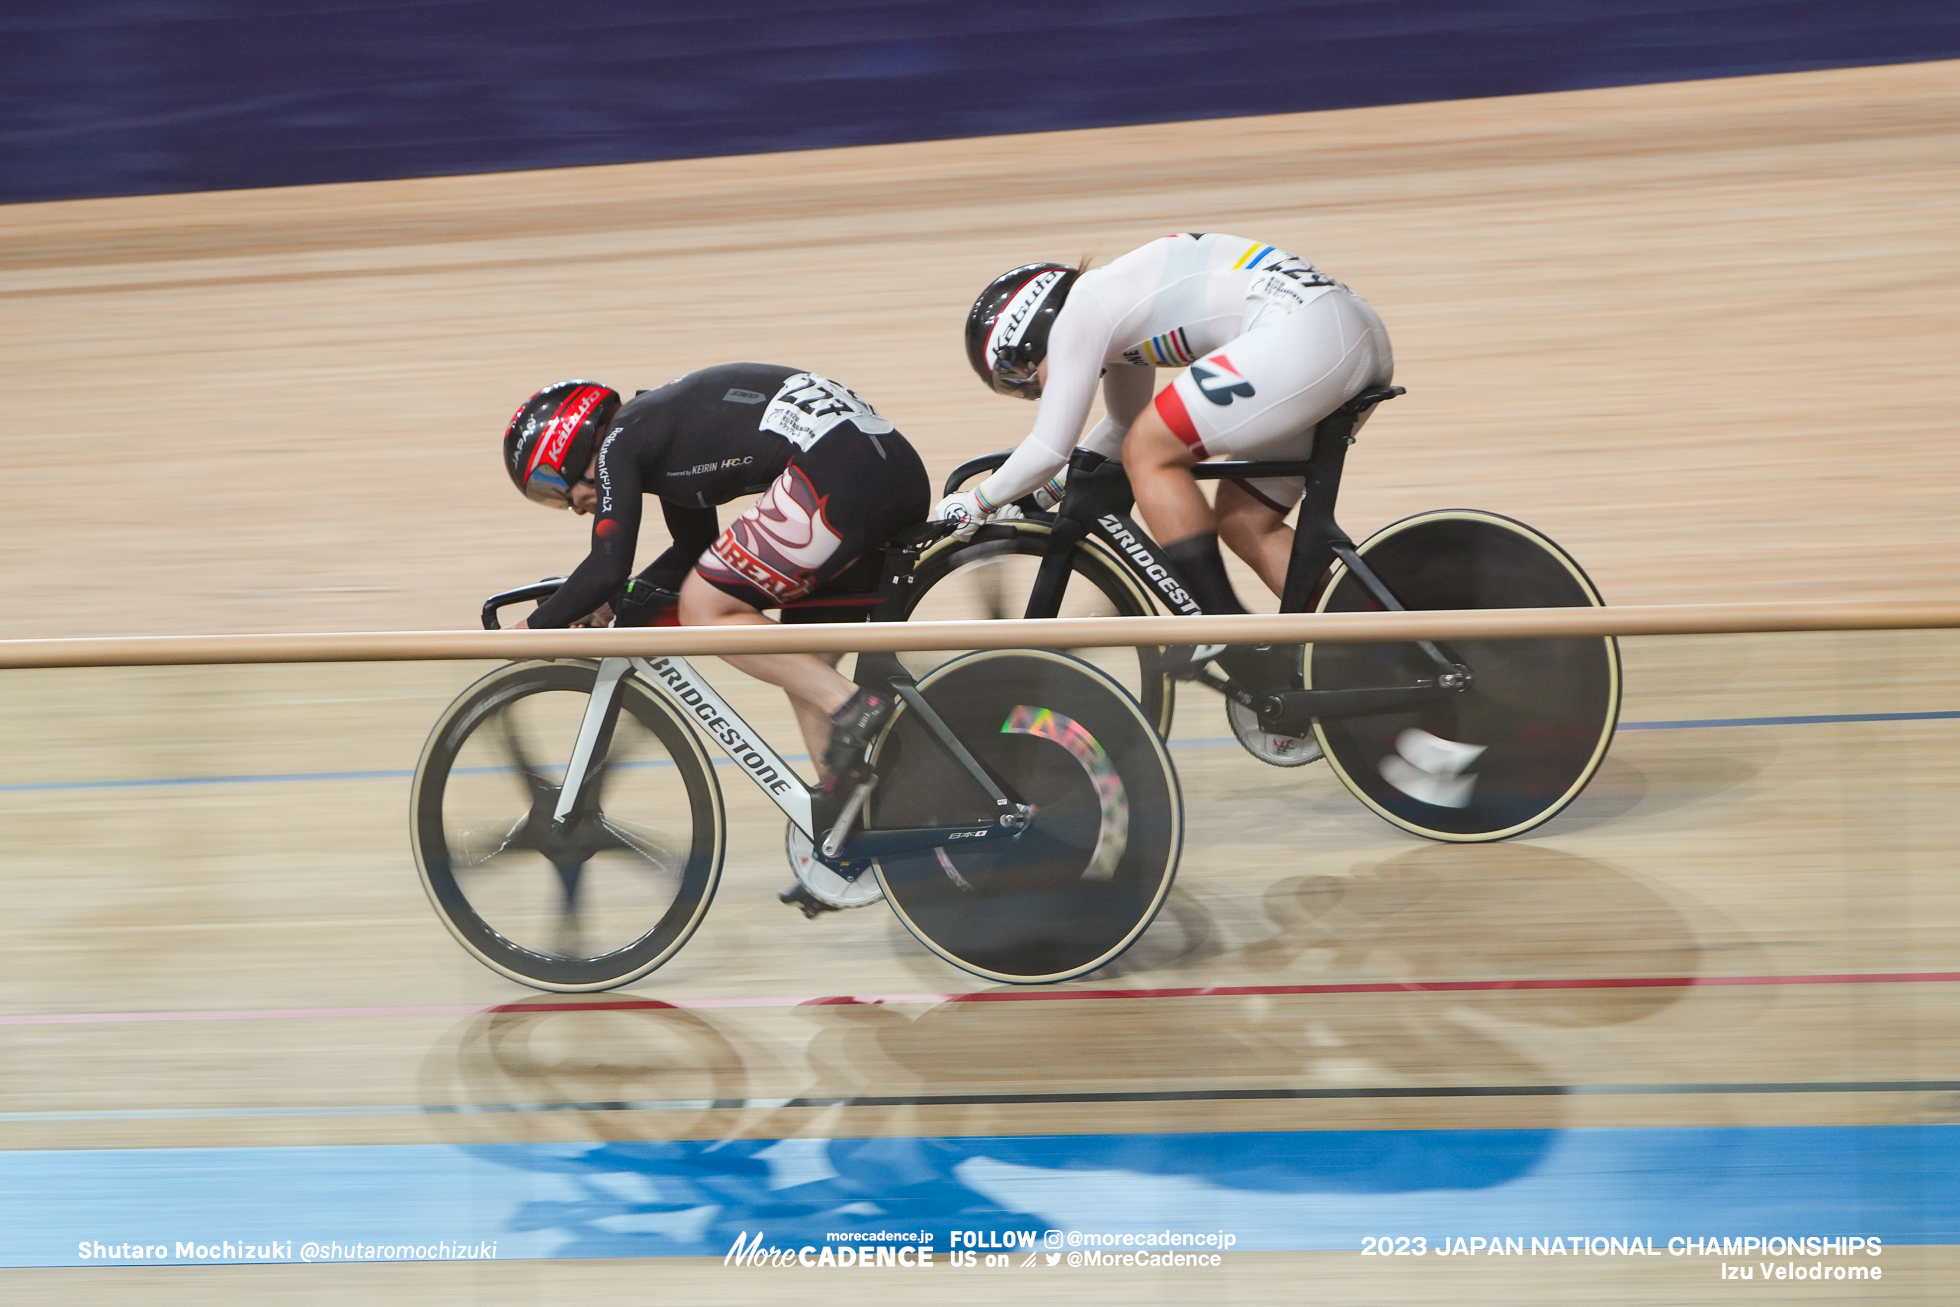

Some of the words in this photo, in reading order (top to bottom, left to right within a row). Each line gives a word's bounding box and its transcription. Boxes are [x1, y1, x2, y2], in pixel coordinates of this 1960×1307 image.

[777, 376, 855, 418] 227
[512, 413, 537, 470] JAPAN
[548, 390, 601, 463] Kabuto
[692, 462, 718, 475] KEIRIN
[643, 656, 792, 796] BRIDGESTONE
